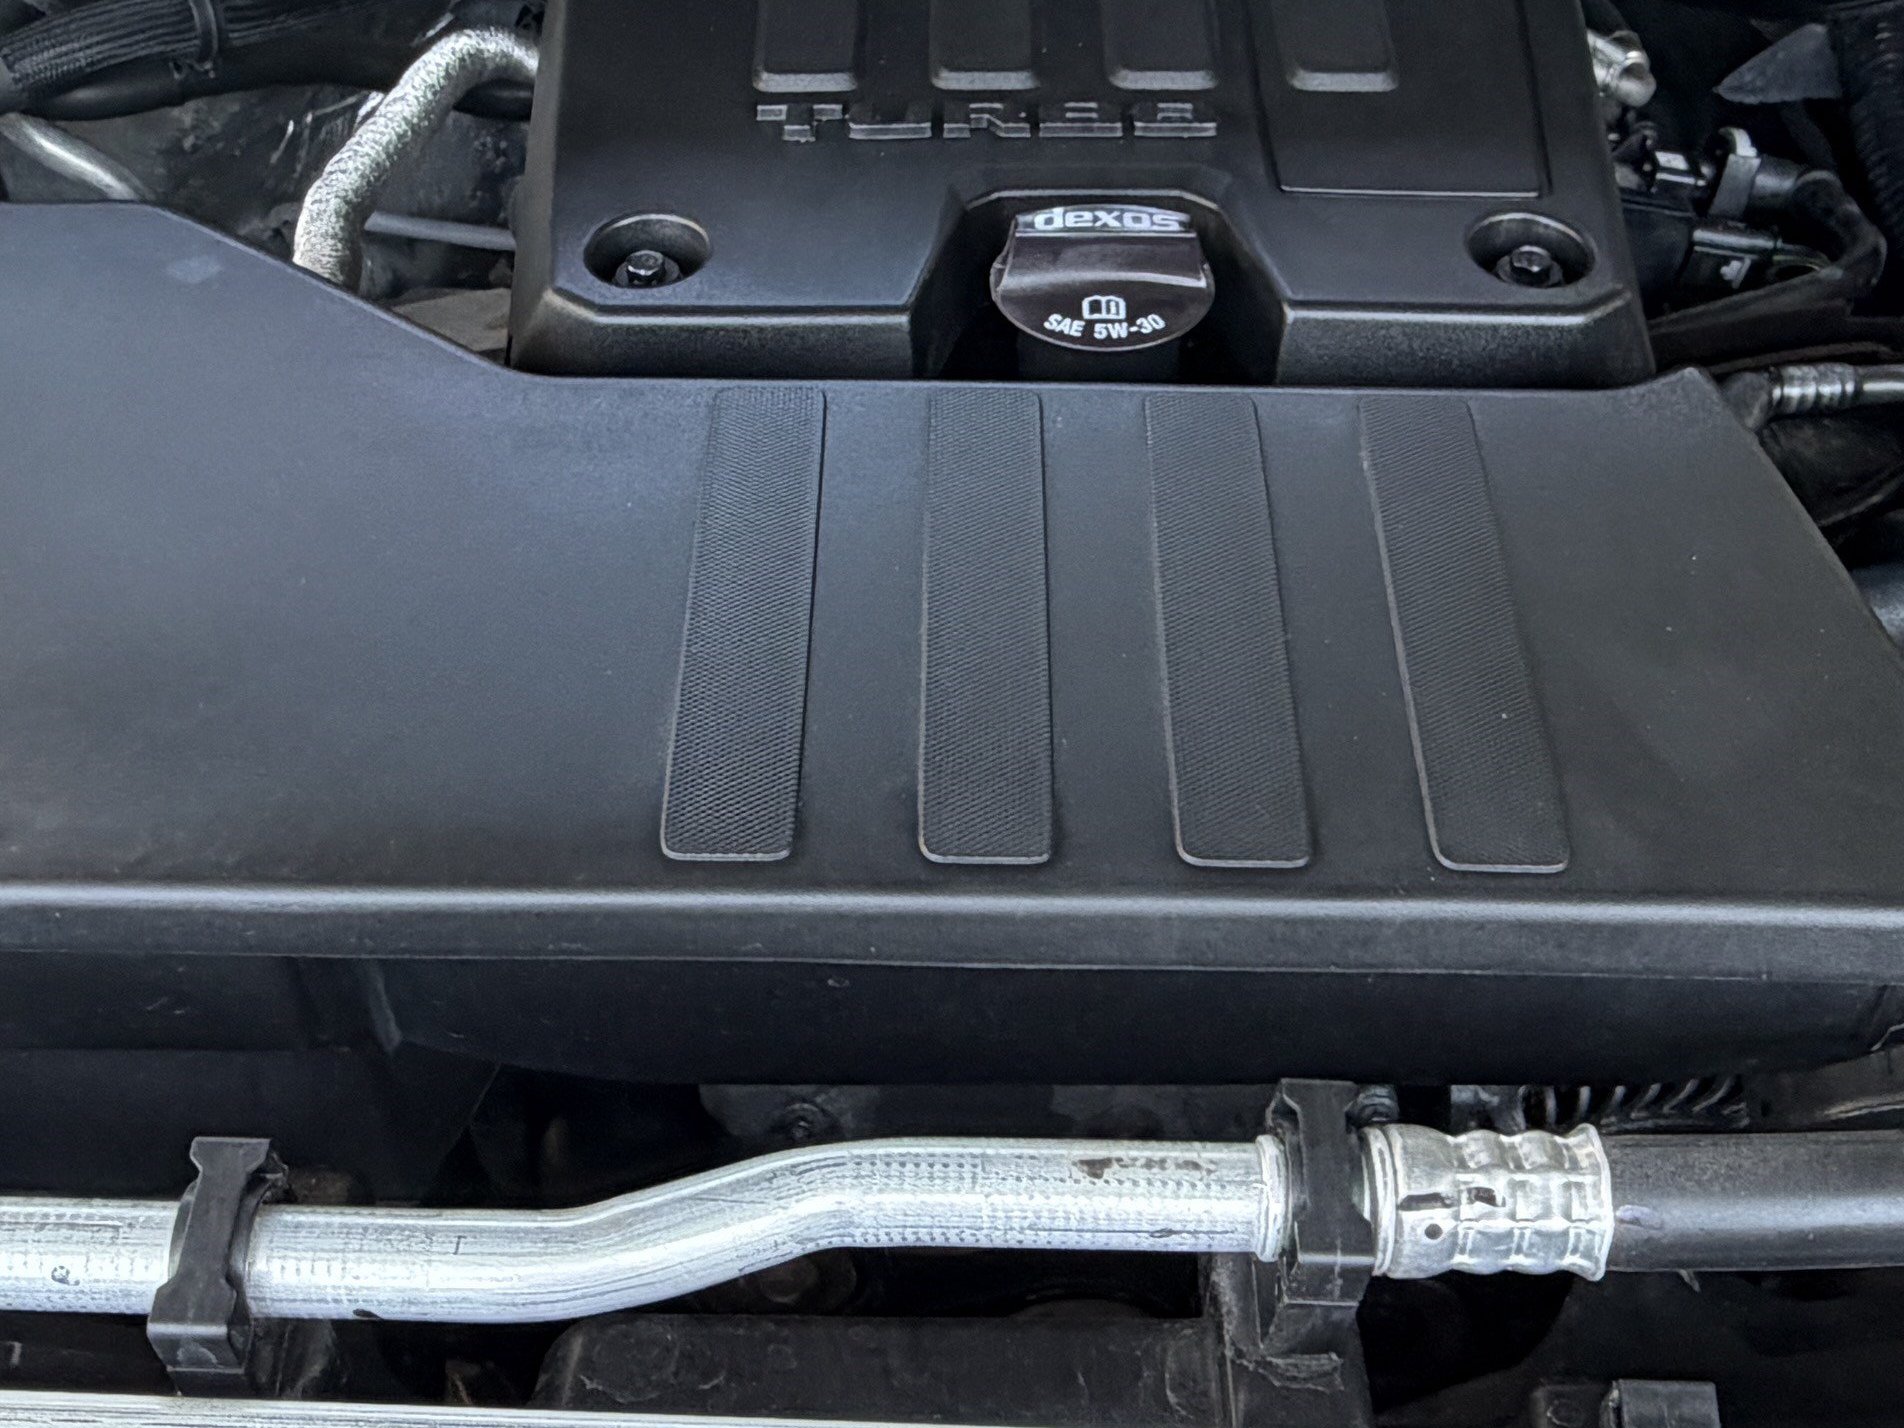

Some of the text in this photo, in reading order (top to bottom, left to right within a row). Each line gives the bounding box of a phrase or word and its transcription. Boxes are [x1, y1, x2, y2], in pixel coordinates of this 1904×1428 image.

[756, 101, 1218, 142] TURBO
[1033, 206, 1182, 231] dexos
[1043, 312, 1167, 340] SAE 5W-30
